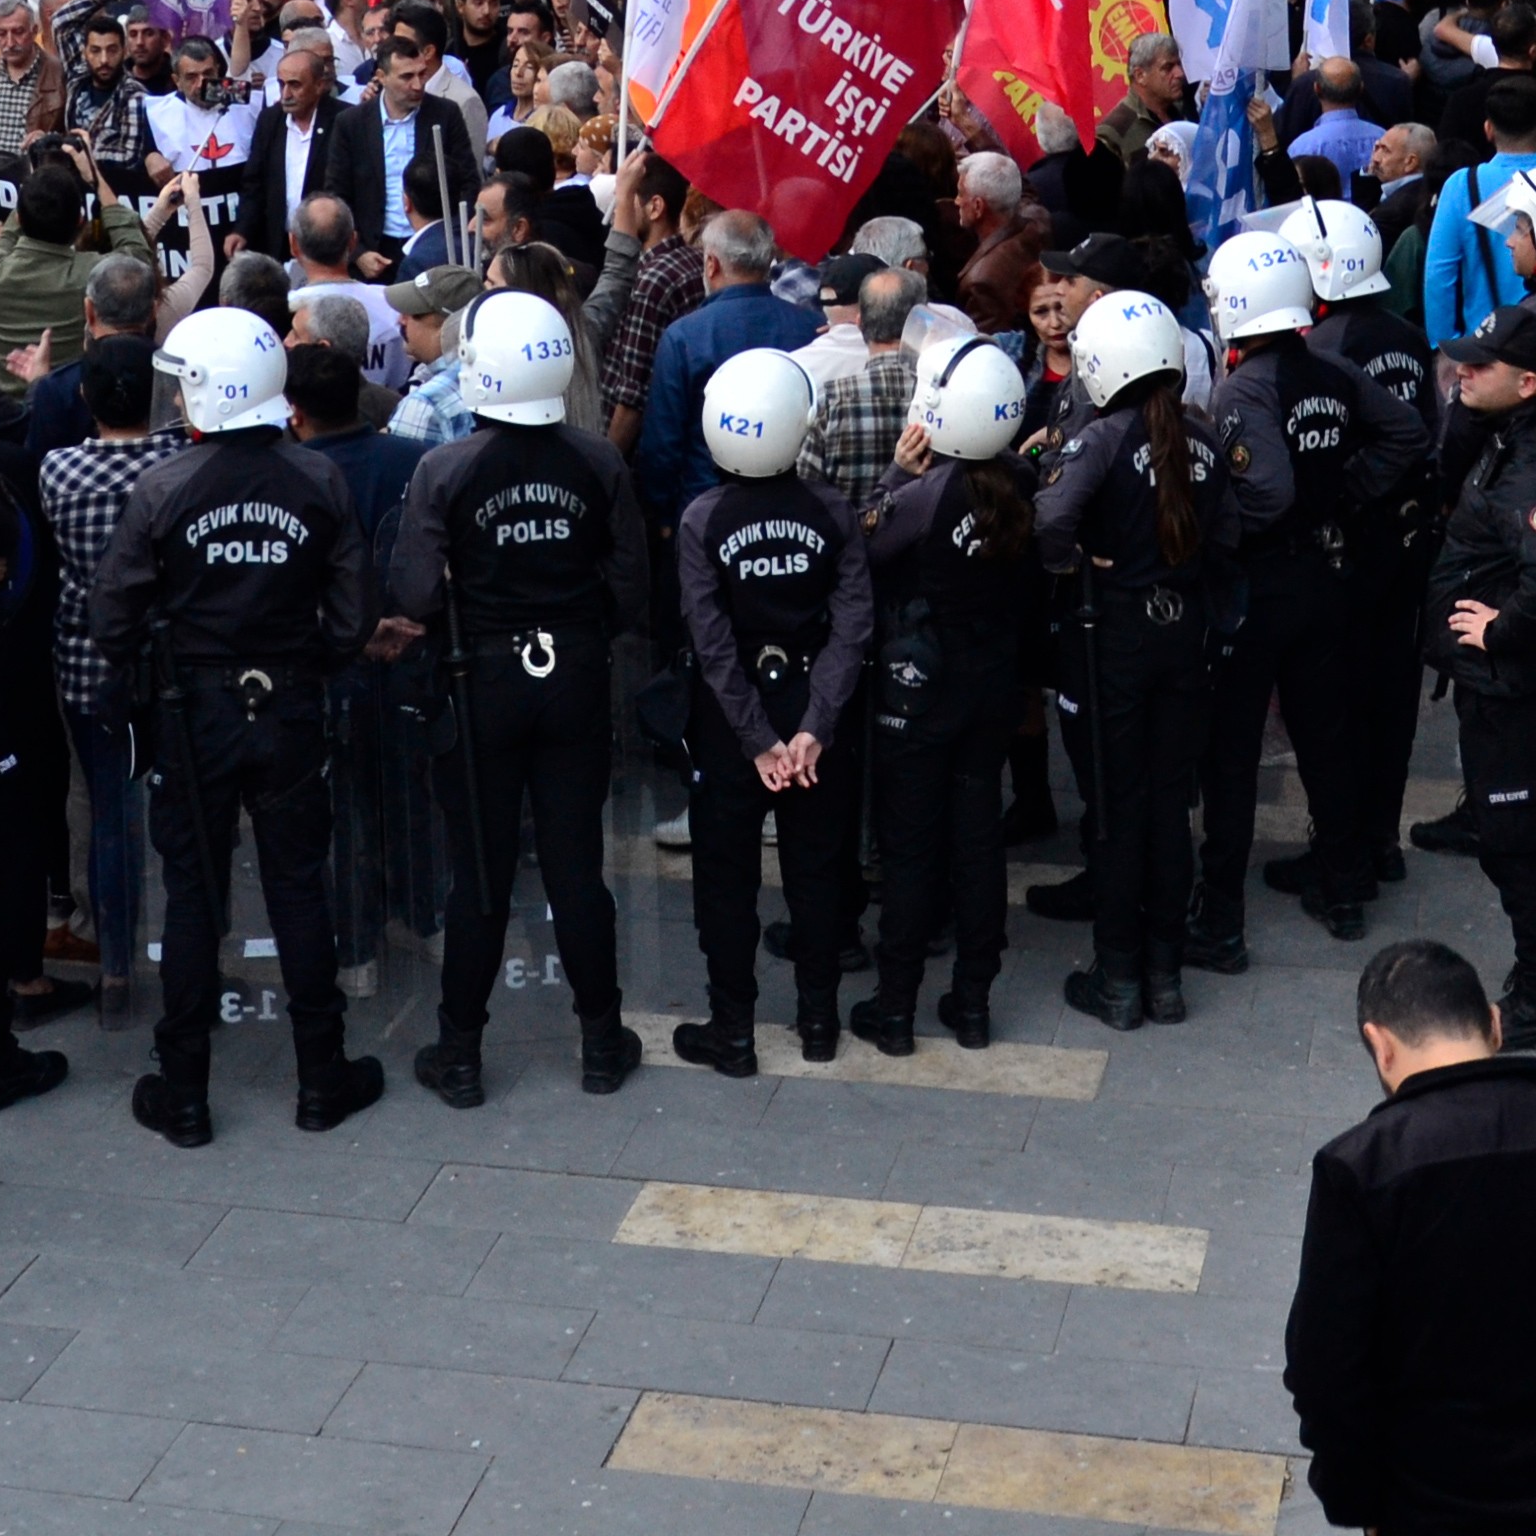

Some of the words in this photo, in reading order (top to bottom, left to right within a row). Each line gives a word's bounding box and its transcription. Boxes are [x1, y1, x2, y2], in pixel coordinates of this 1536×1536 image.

[824, 71, 892, 137] İŞÇİ
[732, 76, 864, 184] PARTİSİ
[1345, 257, 1365, 273] 01
[1122, 301, 1164, 322] K17
[1228, 295, 1247, 311] 01
[520, 337, 573, 363] 1333
[1086, 353, 1101, 375] 01
[224, 384, 249, 401] 01
[481, 374, 503, 394] 01
[719, 411, 764, 439] K21
[925, 409, 943, 430] 01
[474, 484, 522, 532] ÇEVİK
[523, 481, 589, 521] KUVVET
[185, 503, 240, 549] ÇEVİK
[242, 500, 310, 546] KUVVET
[496, 517, 572, 547] POLİS
[765, 519, 826, 556] KUVVET
[206, 540, 290, 566] POLİS
[738, 552, 810, 582] POLİS
